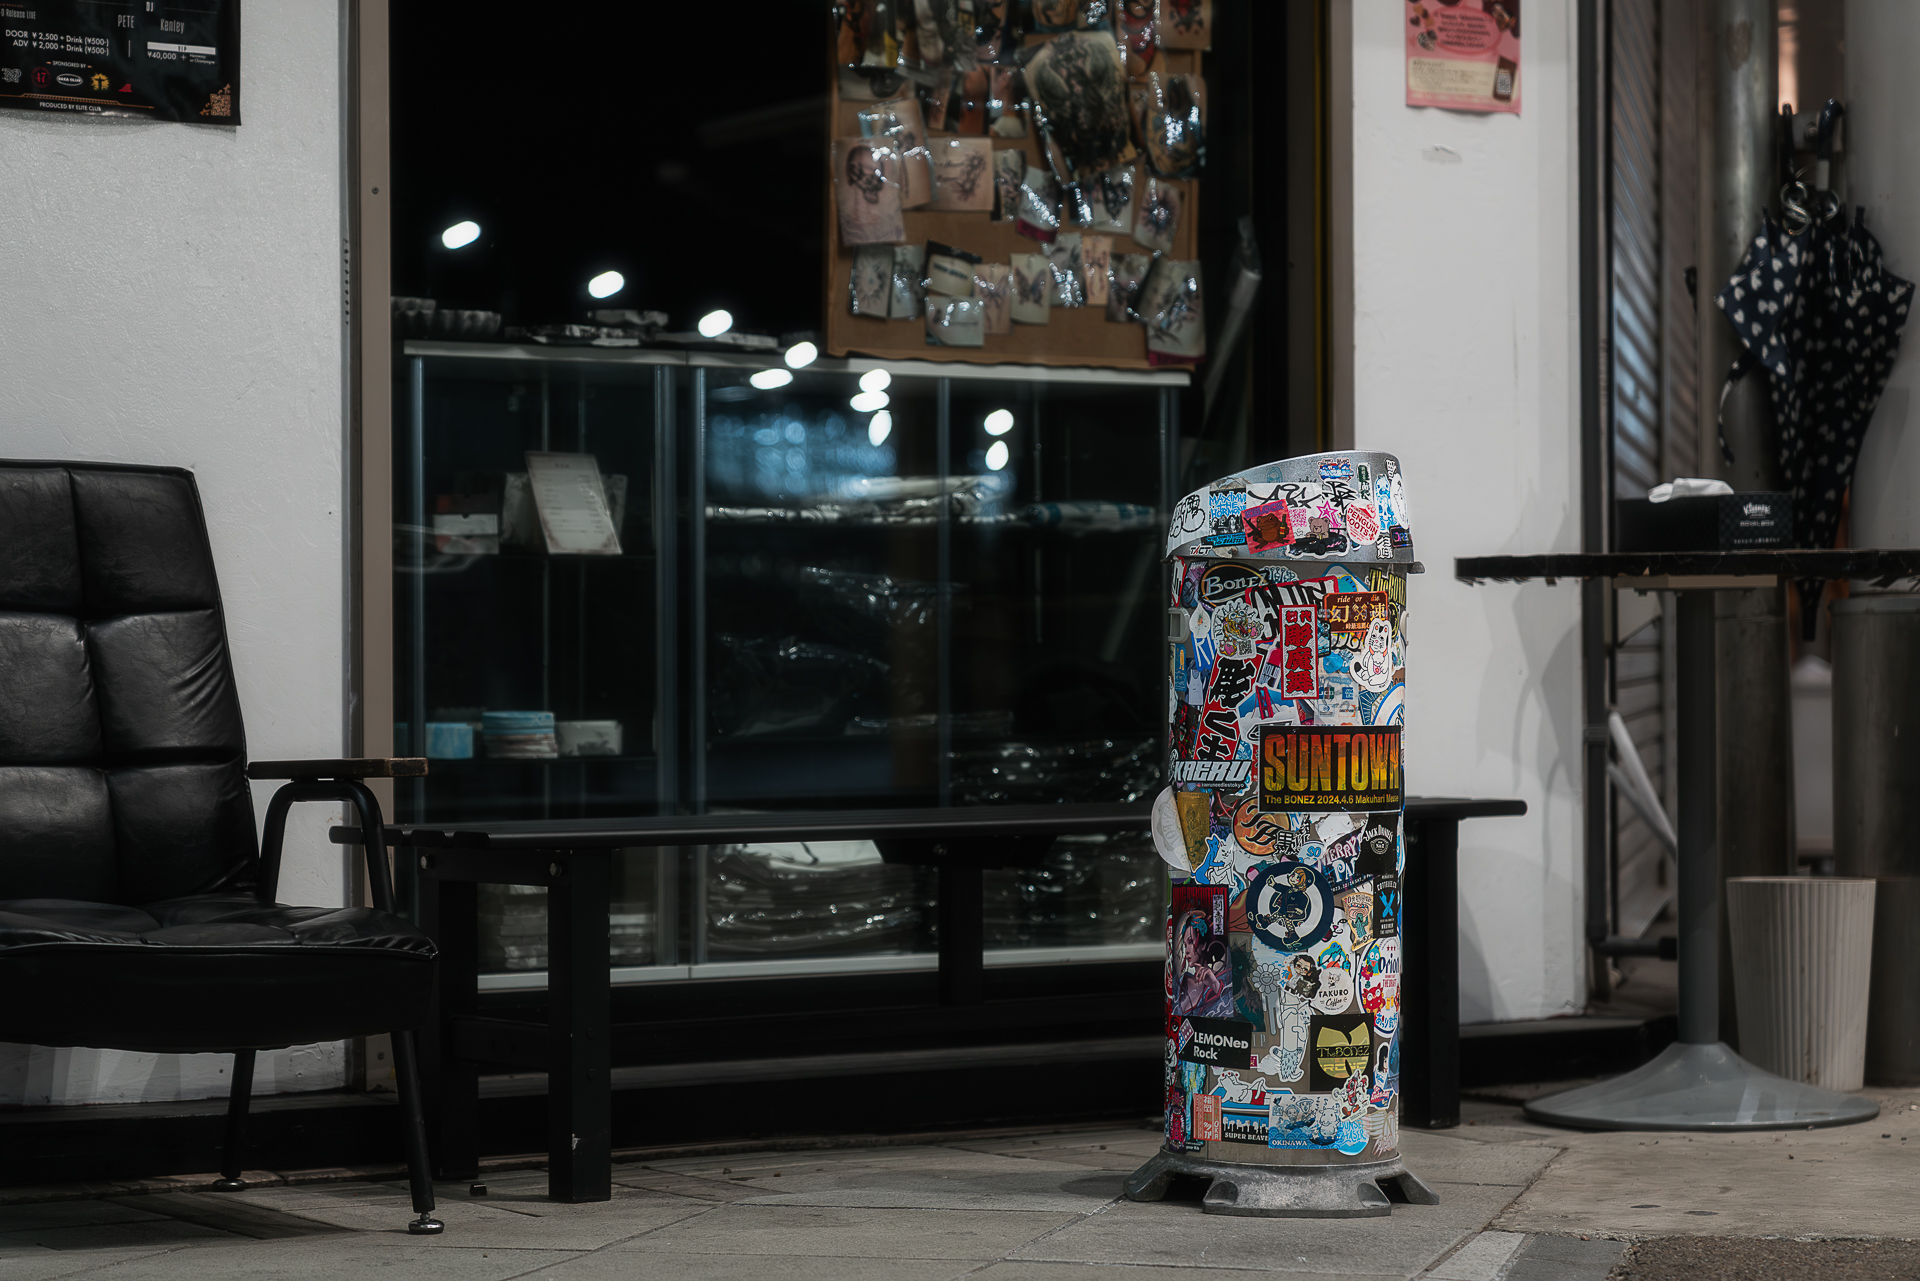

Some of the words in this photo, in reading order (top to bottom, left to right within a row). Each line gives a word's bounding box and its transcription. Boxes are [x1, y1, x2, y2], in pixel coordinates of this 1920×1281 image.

[5, 8, 26, 19] Release
[26, 10, 37, 20] LIVE
[117, 14, 135, 29] PETE
[160, 18, 185, 34] Kenley
[5, 29, 29, 39] DOOR
[38, 32, 59, 41] 2,500
[65, 35, 83, 44] Drink
[12, 39, 29, 48] ADV
[38, 41, 59, 50] 2,000
[66, 44, 83, 53] Drink
[52, 60, 80, 68] SPONSORED
[39, 101, 68, 110] PRODUCED
[1348, 507, 1379, 536] PENGUIN
[1190, 545, 1212, 555] TACT
[1337, 595, 1351, 603] ride
[1370, 594, 1381, 602] die
[1329, 604, 1350, 623] 幻
[1263, 733, 1400, 792] SUNTOWN
[1173, 760, 1252, 782] KAERU
[1264, 794, 1282, 804] The
[1284, 794, 1315, 804] BONEZ
[1317, 794, 1354, 805] 2024.4.6
[1355, 793, 1385, 804] Makuhari
[1379, 952, 1399, 974] Orion
[1318, 988, 1349, 998] TAKURO
[1194, 1031, 1249, 1049] LEMONeD
[1193, 1045, 1218, 1060] Rock
[1224, 1132, 1247, 1140] SUPER
